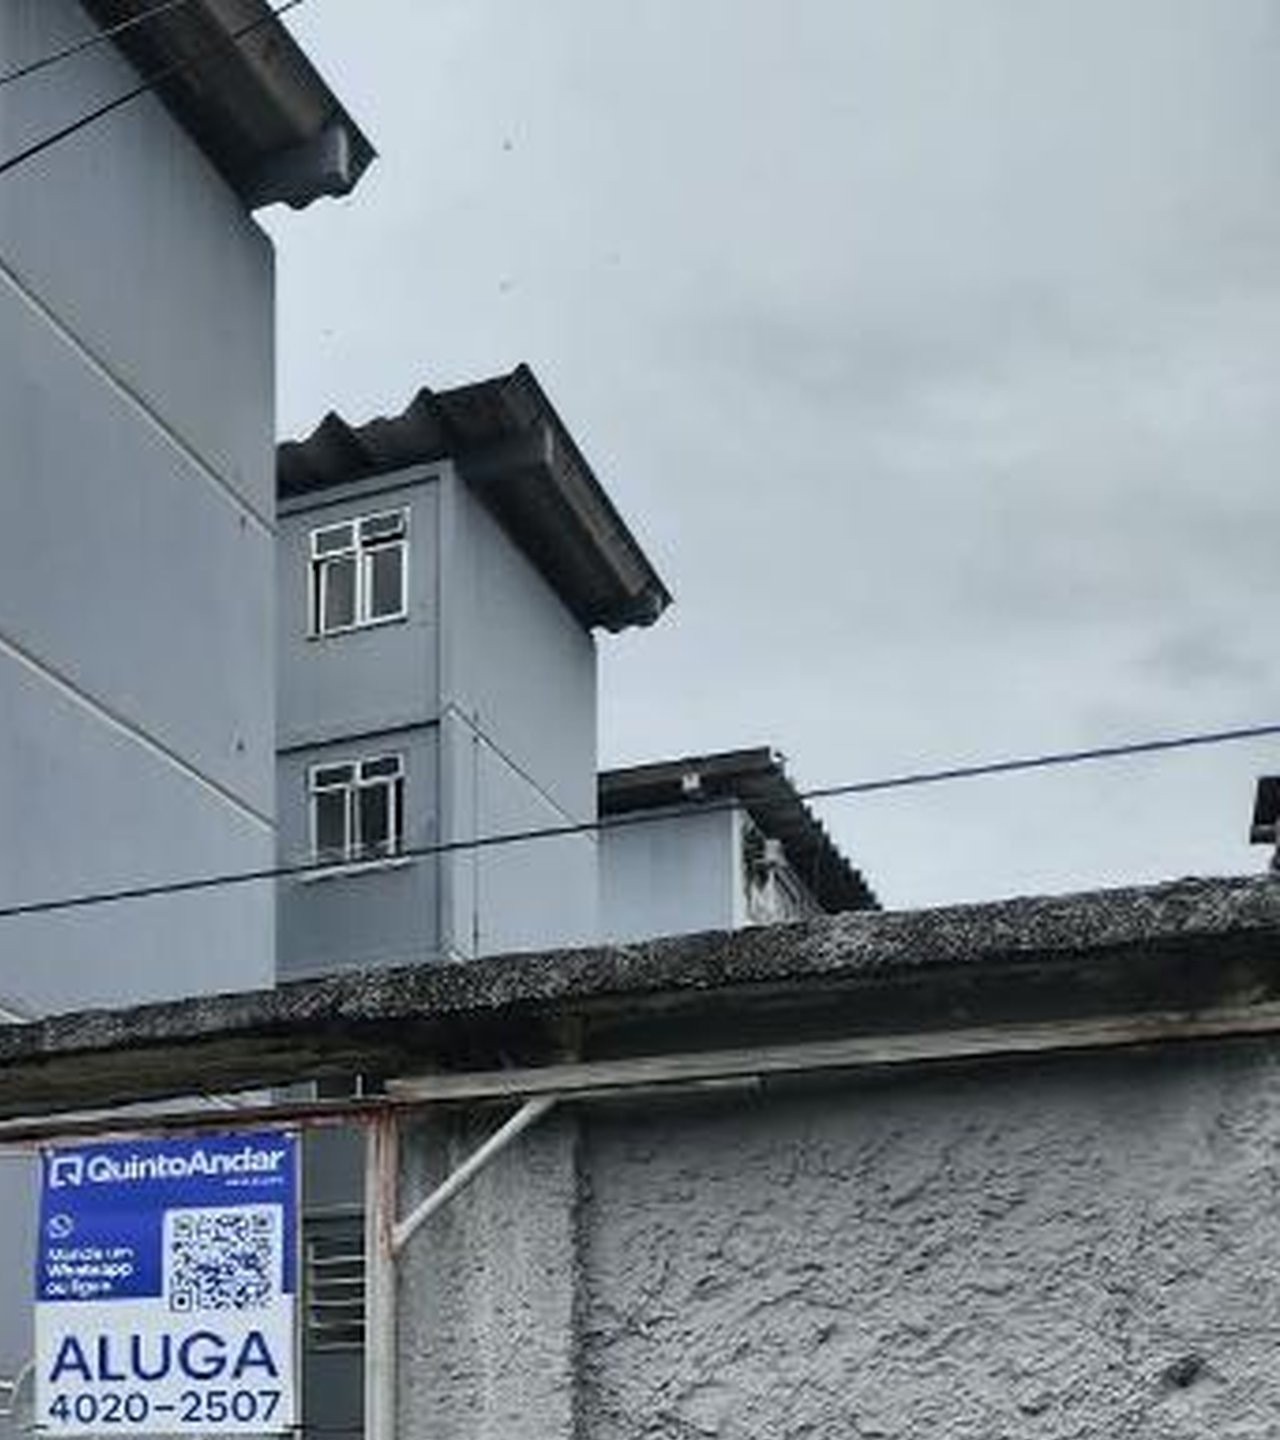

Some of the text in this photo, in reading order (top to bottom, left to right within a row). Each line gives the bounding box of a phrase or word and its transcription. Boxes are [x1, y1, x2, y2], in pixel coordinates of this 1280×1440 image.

[89, 1146, 285, 1181] QuintoAndar
[49, 1331, 279, 1383] ALUGA
[49, 1391, 282, 1424] 4020-2507
